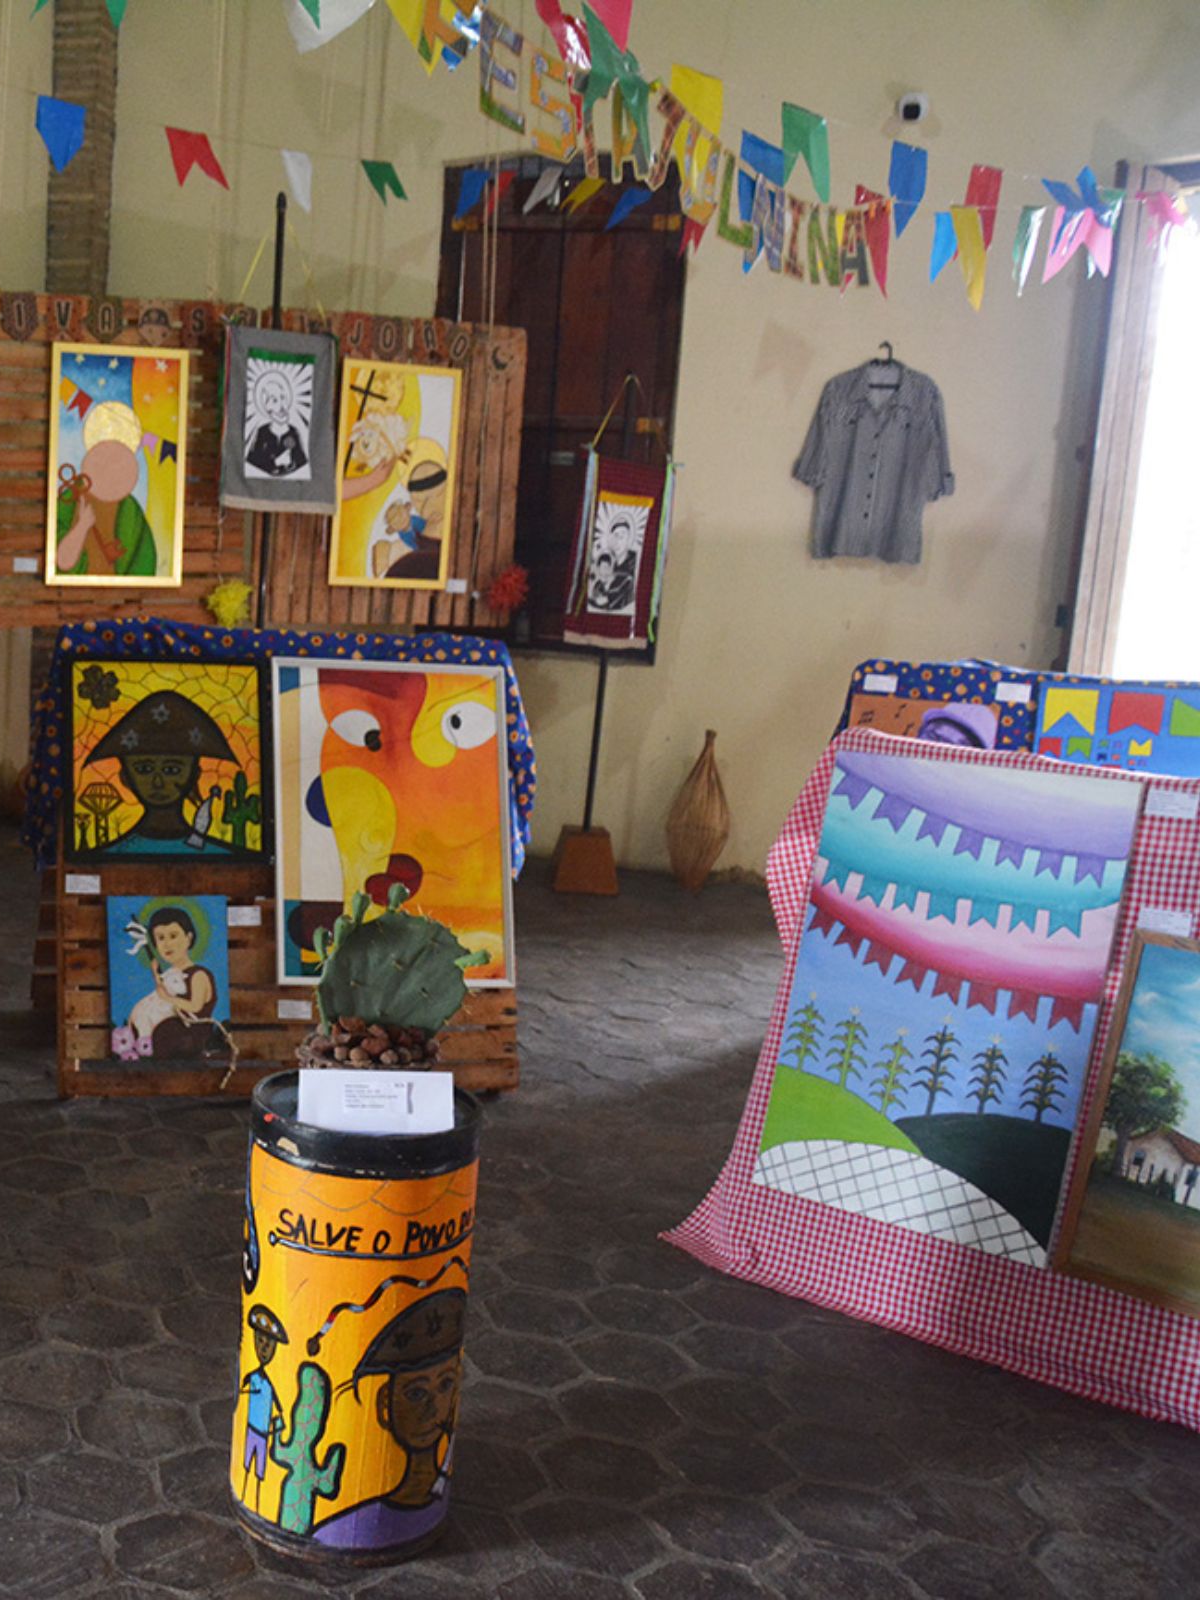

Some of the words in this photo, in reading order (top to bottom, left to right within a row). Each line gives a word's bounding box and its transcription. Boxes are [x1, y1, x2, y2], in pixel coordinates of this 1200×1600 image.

[276, 1208, 364, 1252] SALVE
[372, 1230, 392, 1254] O
[402, 1219, 457, 1254] POVO
